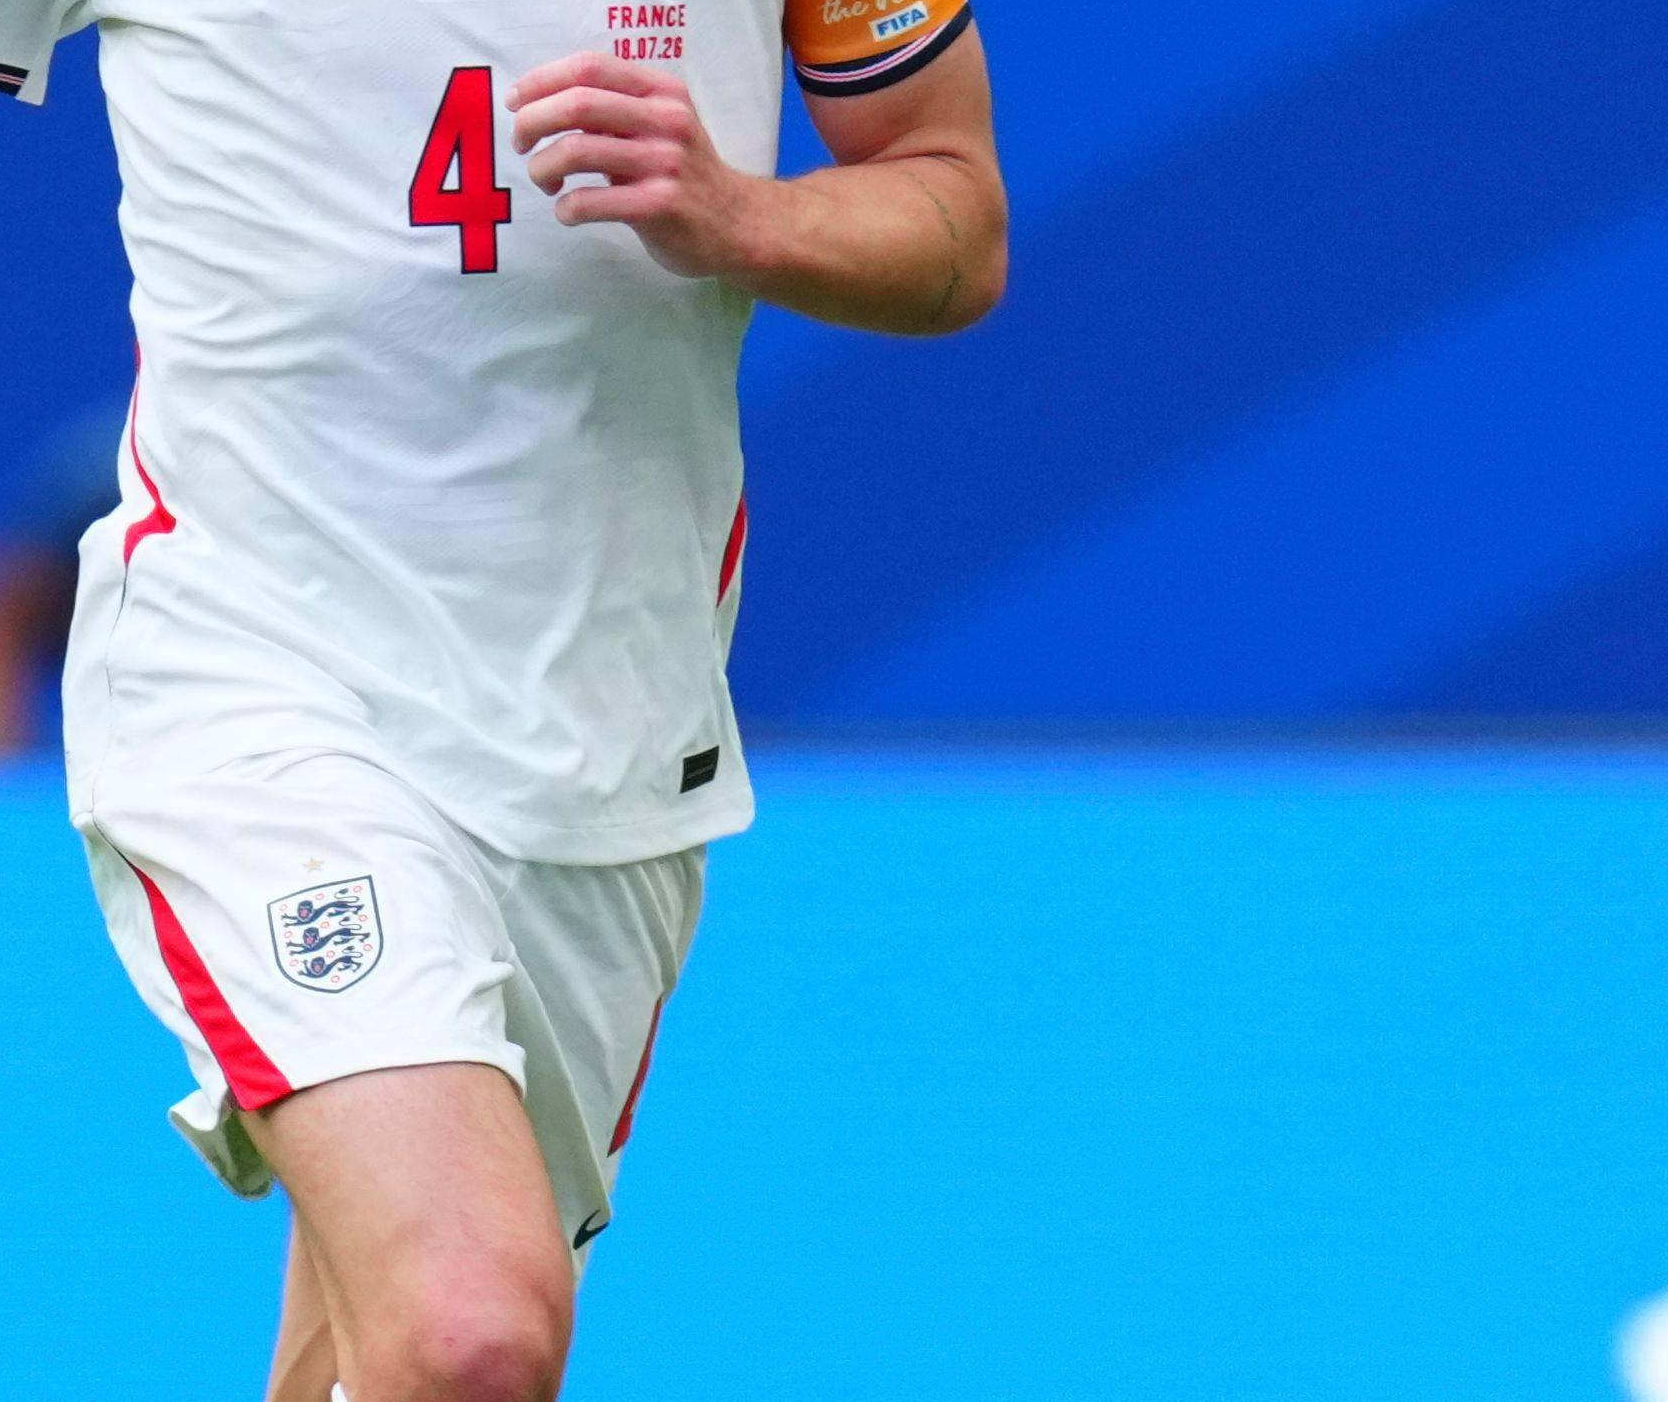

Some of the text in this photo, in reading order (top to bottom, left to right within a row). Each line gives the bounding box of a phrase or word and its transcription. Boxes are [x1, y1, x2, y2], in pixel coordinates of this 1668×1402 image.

[608, 4, 686, 29] FRANCE
[876, 7, 926, 37] FIFA
[614, 36, 682, 60] 18.07.26
[408, 65, 512, 275] 4
